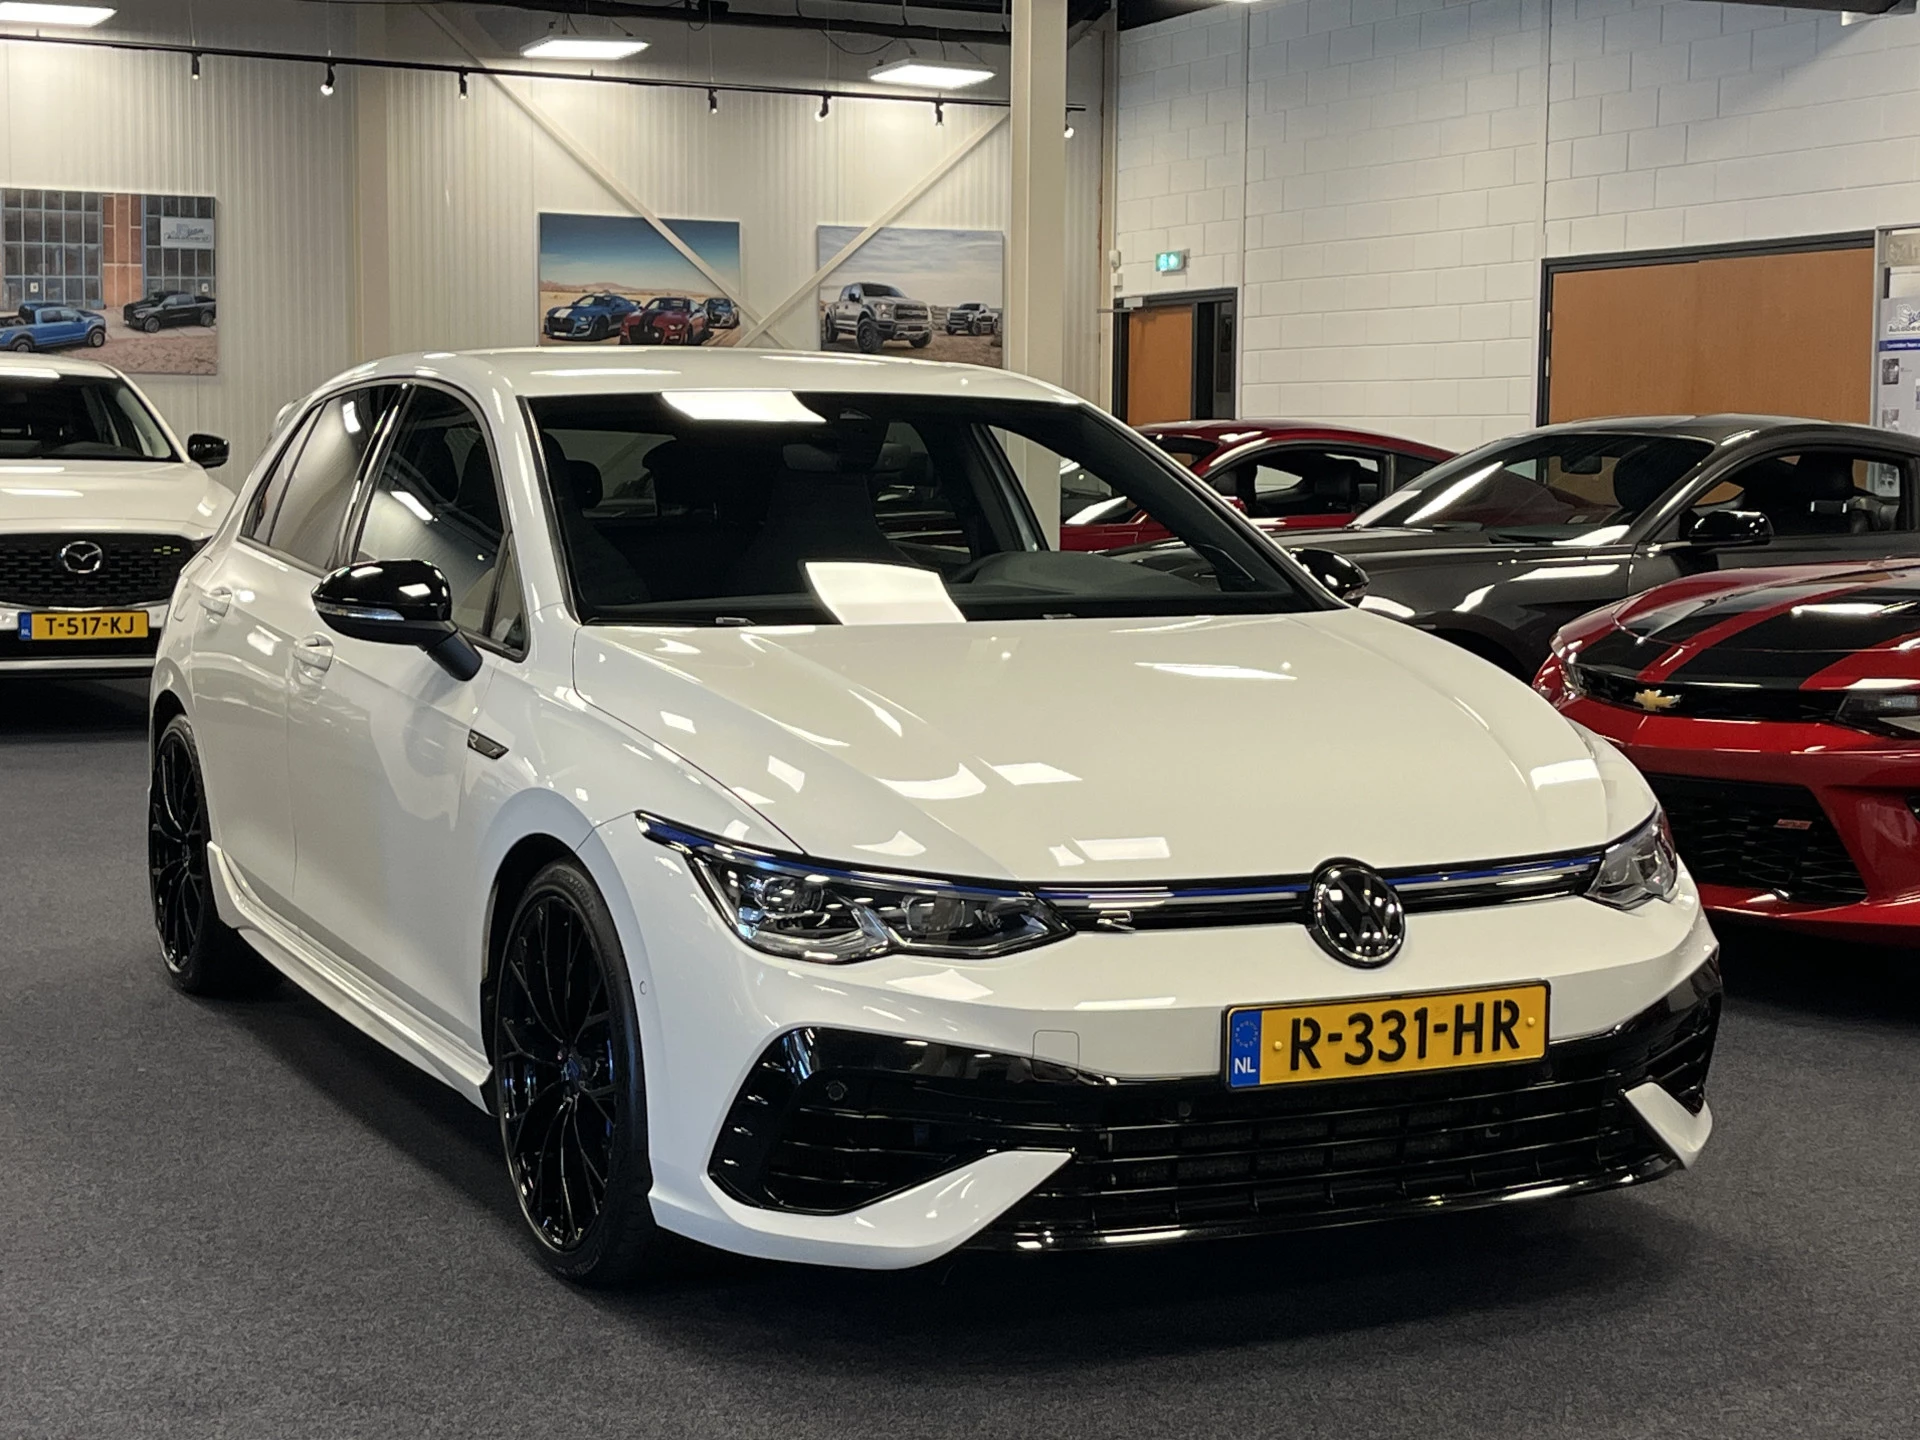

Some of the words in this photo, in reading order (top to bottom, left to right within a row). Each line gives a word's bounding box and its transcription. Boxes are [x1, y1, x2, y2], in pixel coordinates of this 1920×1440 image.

[45, 616, 135, 636] T-517-KJ
[1289, 998, 1521, 1071] R-331-HR
[1233, 1055, 1257, 1075] NL
